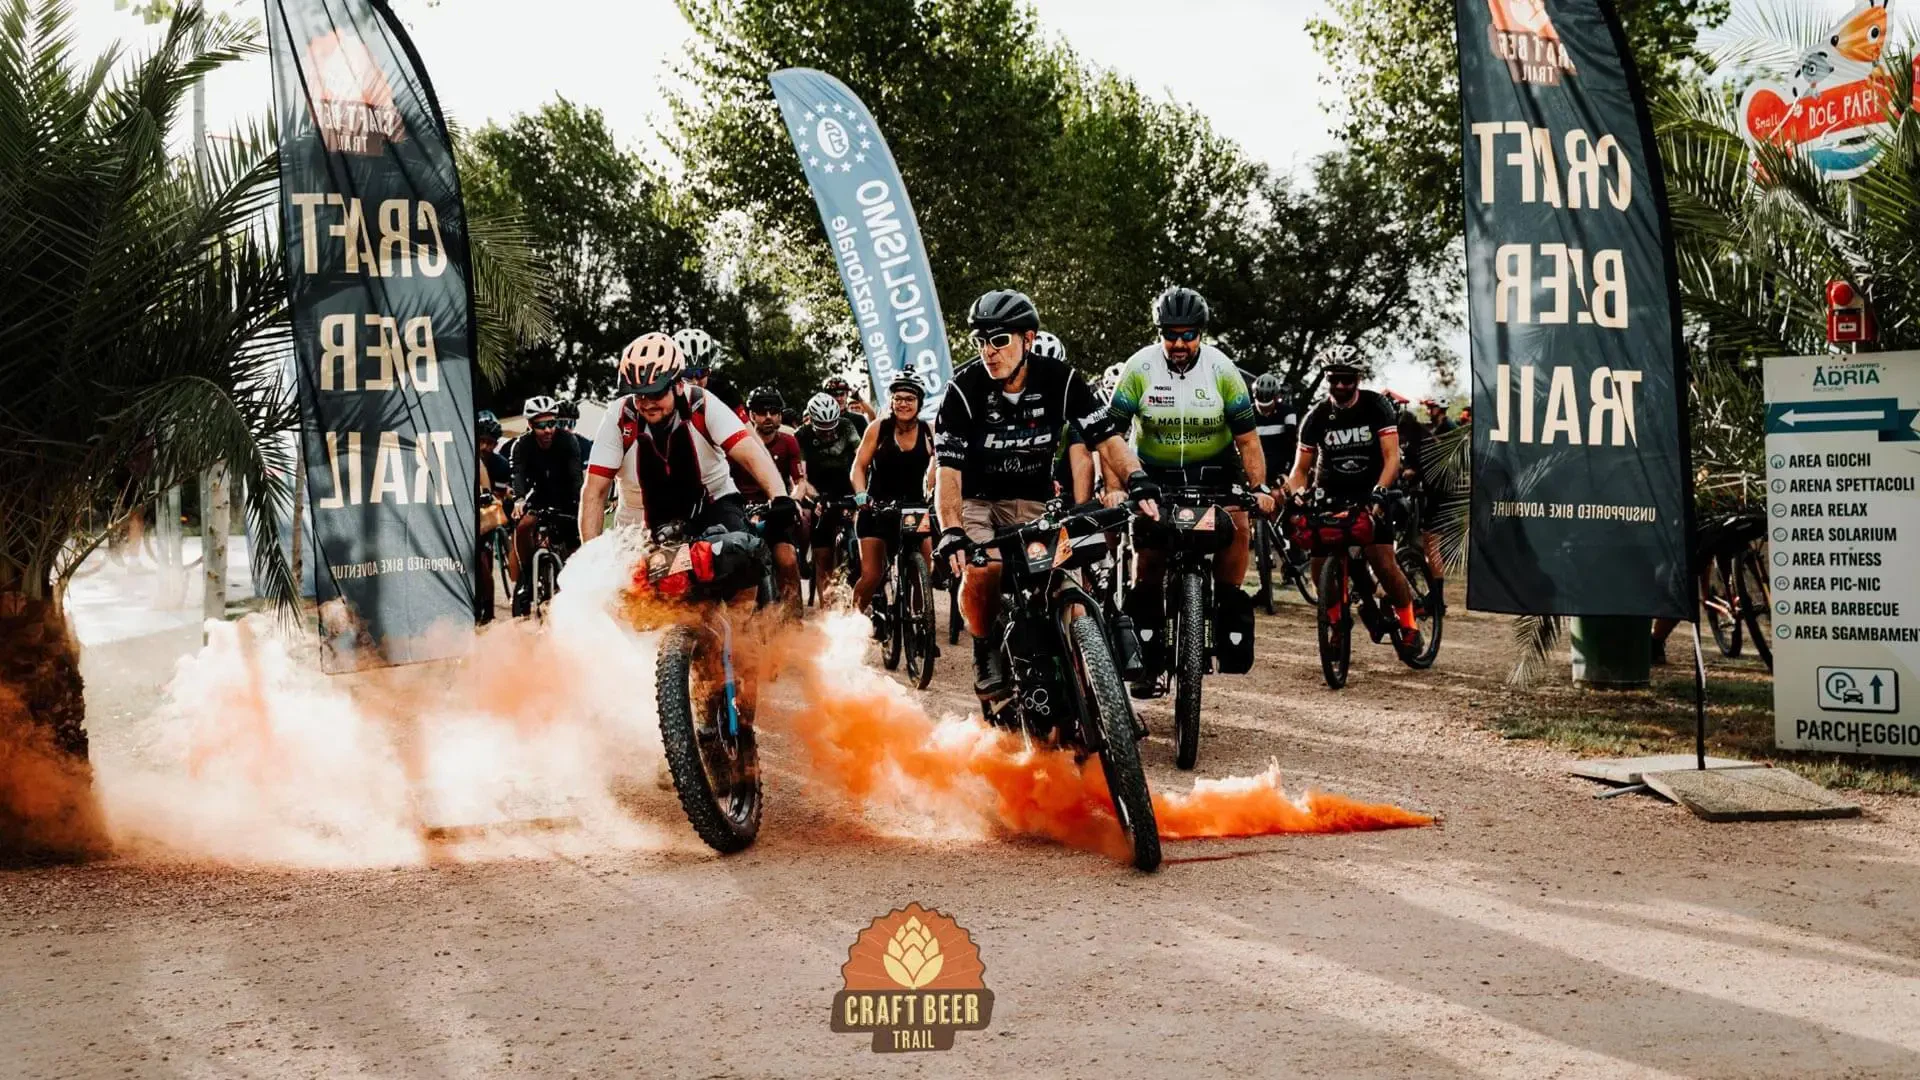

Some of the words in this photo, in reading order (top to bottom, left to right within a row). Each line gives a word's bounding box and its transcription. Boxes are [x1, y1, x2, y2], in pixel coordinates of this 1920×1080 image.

[1755, 114, 1779, 130] Small
[1809, 101, 1837, 130] DOG
[1813, 366, 1880, 386] ADRIA
[1789, 454, 1821, 468] AREA
[1826, 453, 1871, 467] GIOCHI
[1790, 479, 1832, 492] ARENA
[1836, 477, 1915, 492] SPETTACOLI
[1791, 503, 1823, 517] AREA
[1828, 503, 1868, 517] RELAX
[1791, 528, 1824, 541] AREA
[1828, 527, 1897, 542] SOLARIUM
[1792, 553, 1825, 566] AREA
[1830, 553, 1882, 567] FITNESS
[1793, 577, 1826, 591] AREA
[1830, 577, 1881, 591] PIC-NIC
[1794, 601, 1826, 615] AREA
[1831, 602, 1899, 616] BARBECUE
[1795, 626, 1827, 640] AREA
[1832, 627, 1920, 642] SGAMBAMEN
[1835, 679, 1847, 694] P
[1796, 719, 1920, 746] PARCHEGGIO
